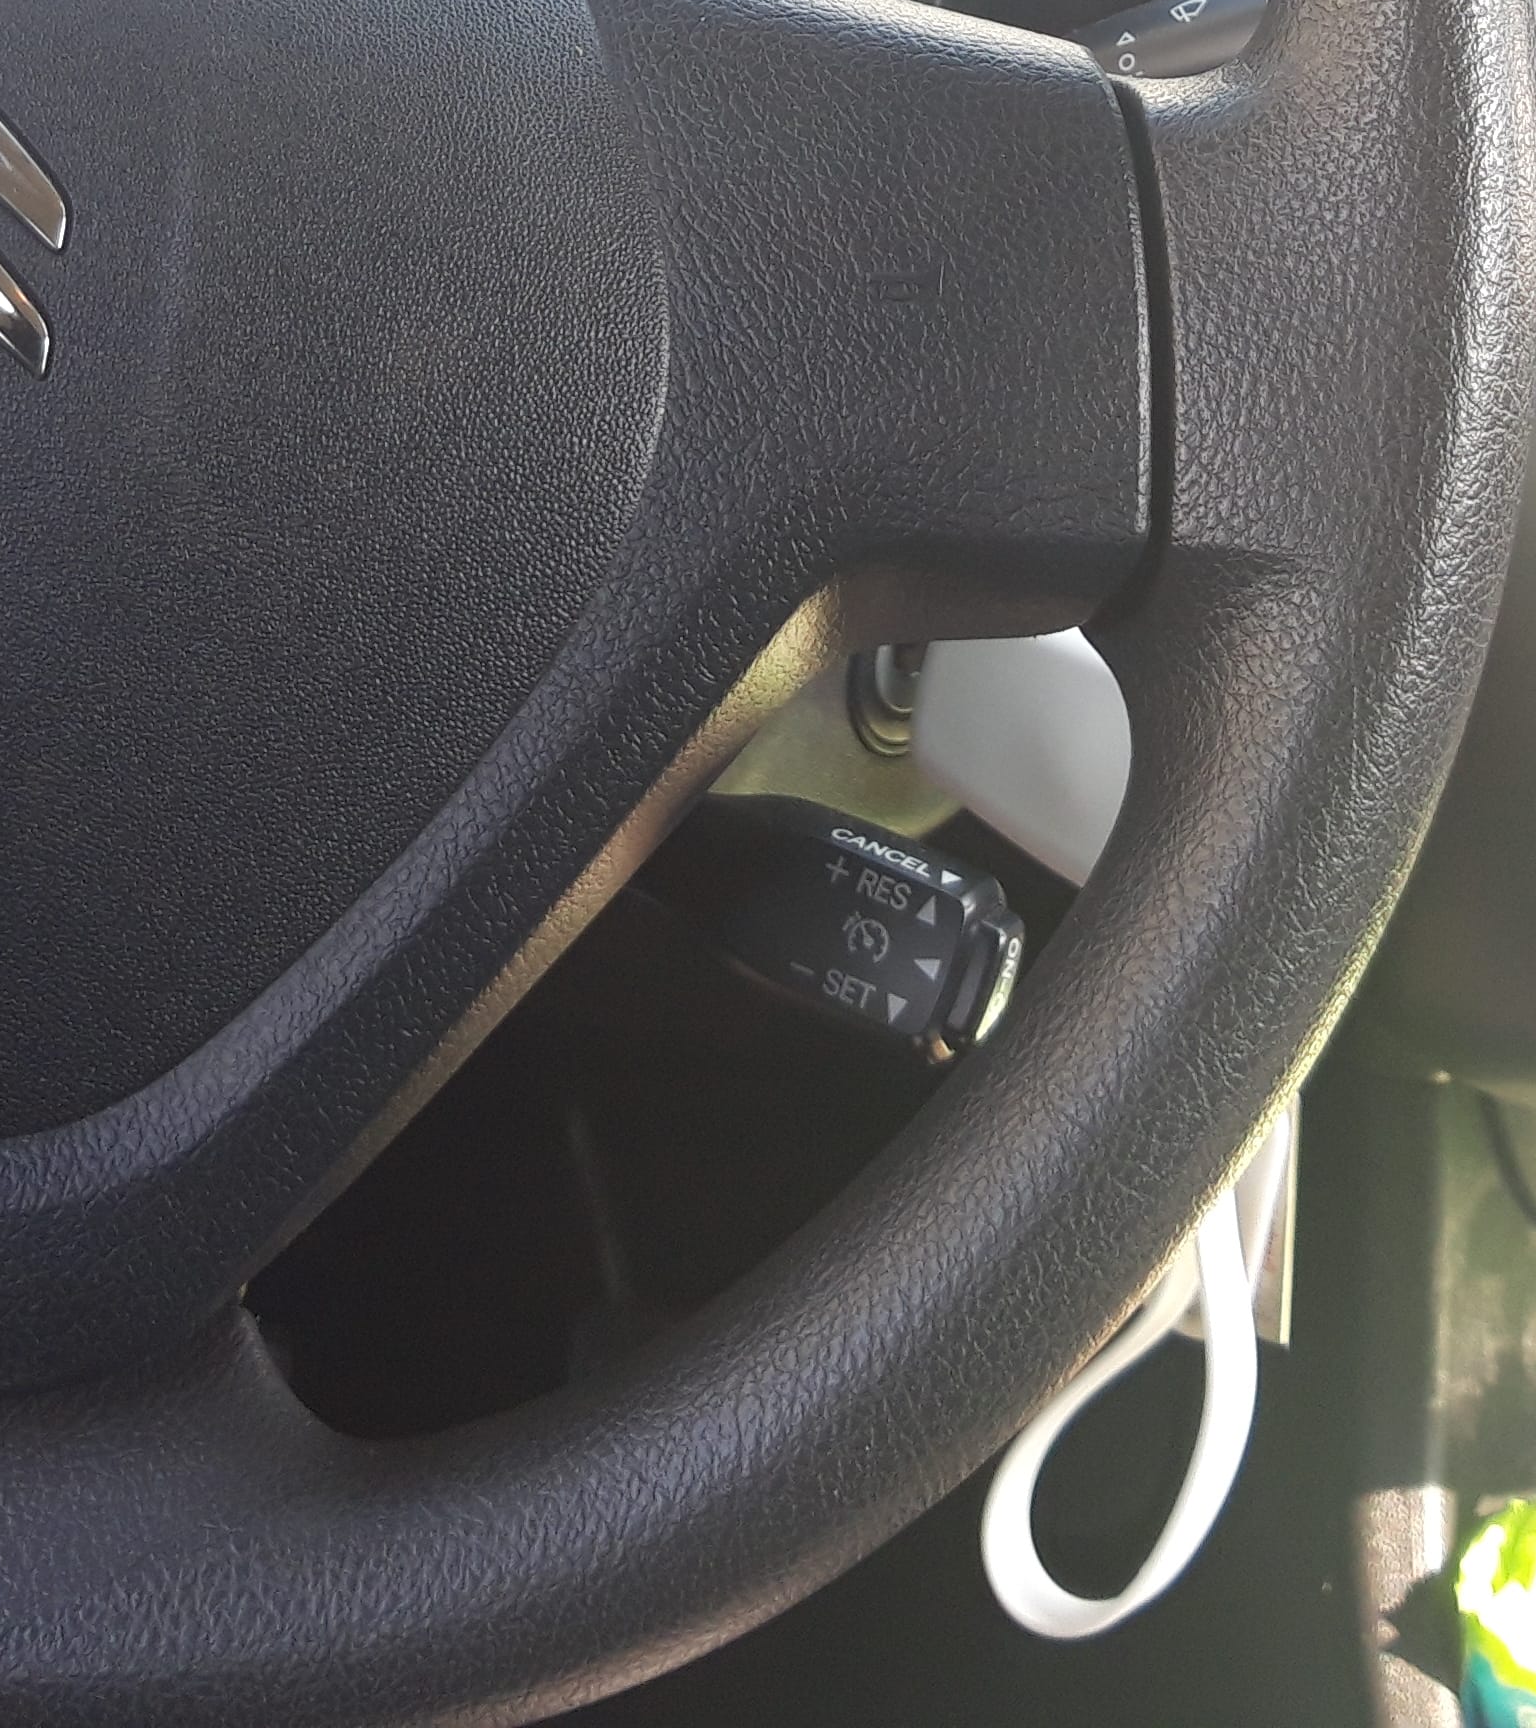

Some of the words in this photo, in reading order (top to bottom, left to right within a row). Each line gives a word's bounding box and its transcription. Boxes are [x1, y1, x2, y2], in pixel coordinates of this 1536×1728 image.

[830, 827, 932, 879] CANCEL
[855, 867, 913, 911] RES
[822, 968, 878, 1010] SET
